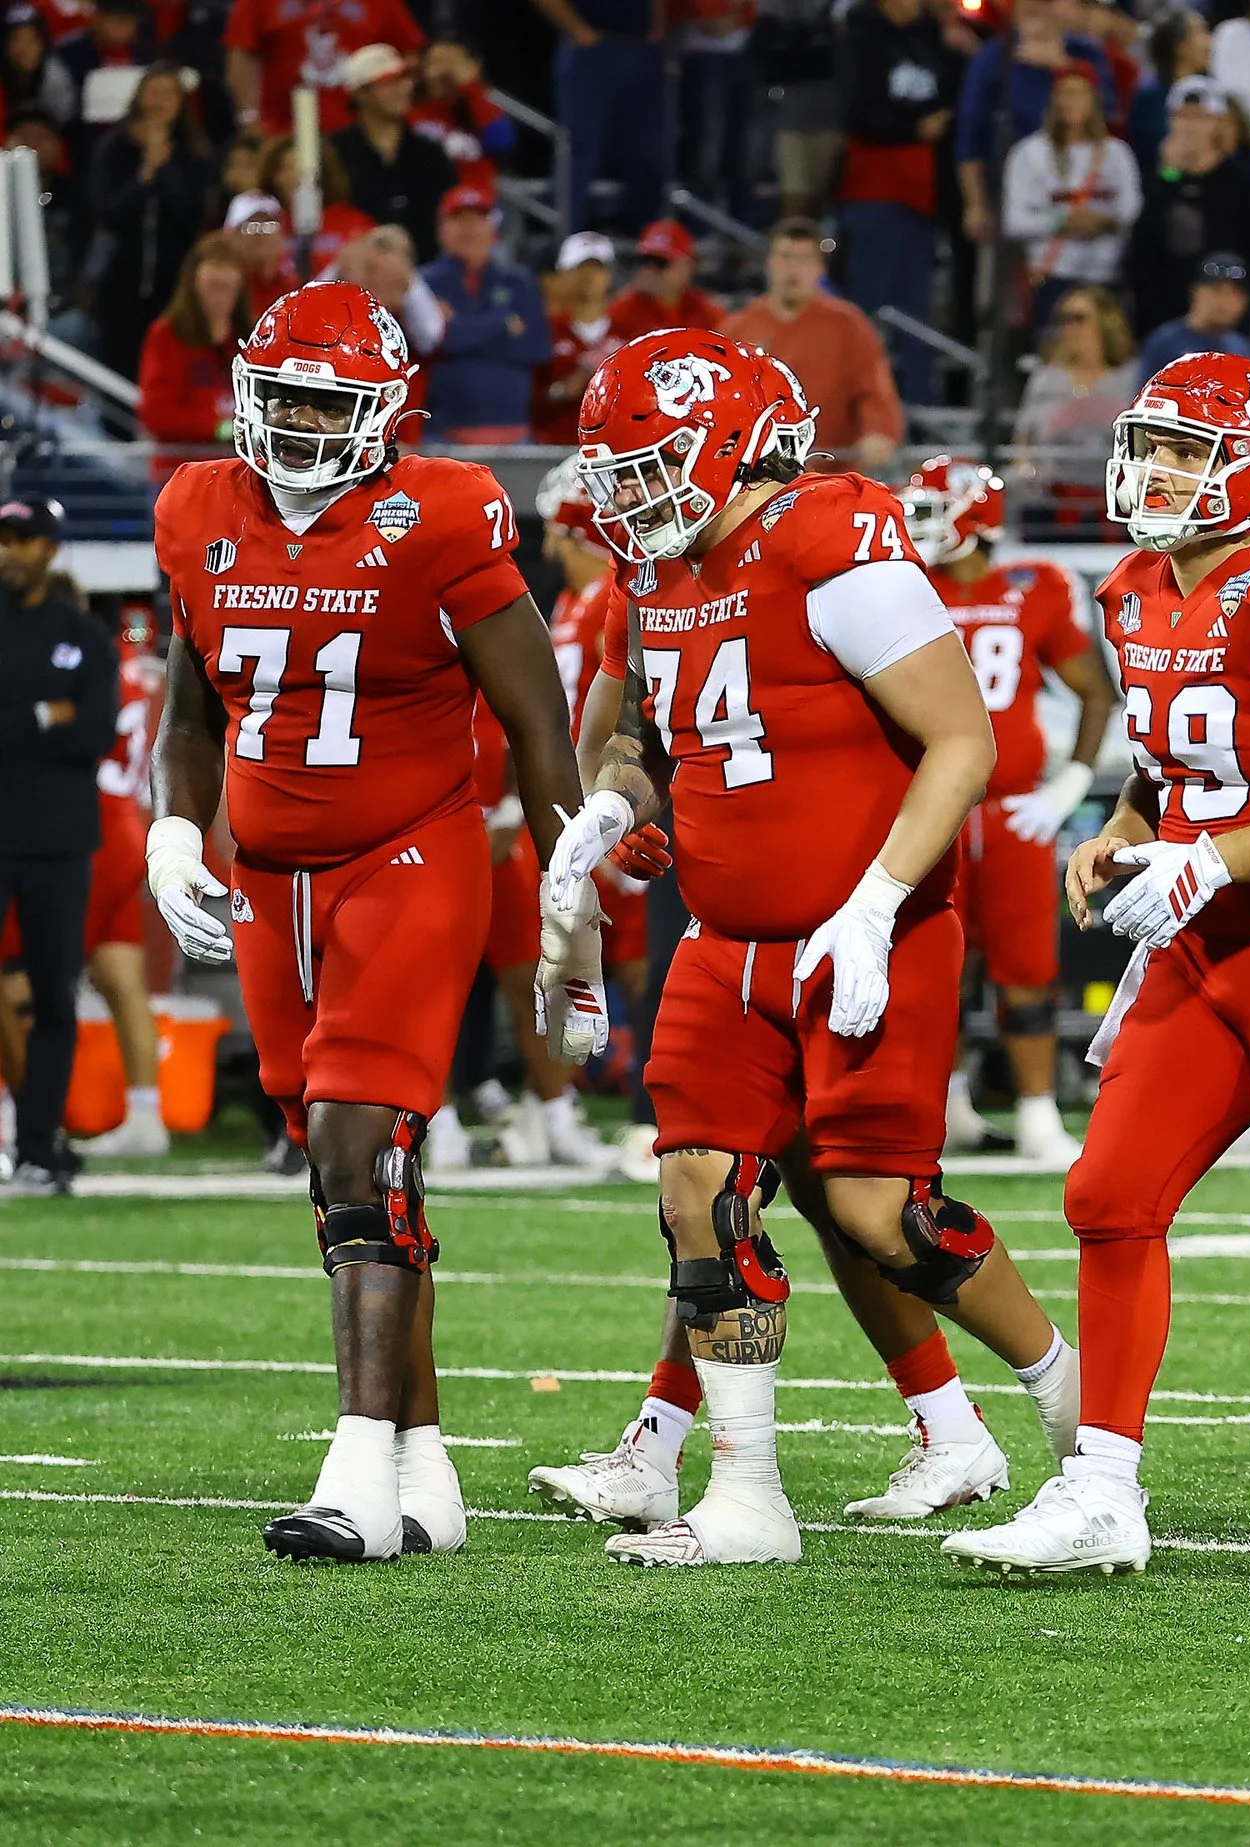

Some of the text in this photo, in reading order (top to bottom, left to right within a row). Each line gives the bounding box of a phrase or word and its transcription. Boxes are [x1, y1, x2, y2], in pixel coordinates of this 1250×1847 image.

[373, 509, 416, 519] ARIZONA
[379, 517, 408, 526] BOWL
[852, 512, 905, 562] 74
[213, 584, 379, 614] FRESNO STATE
[639, 590, 749, 632] FRESNO STATE
[956, 624, 1024, 712] 8
[1124, 641, 1226, 673] FRESNO STATE
[217, 626, 363, 767] 71
[642, 637, 774, 790] 74
[1122, 683, 1250, 822] 69
[738, 1311, 780, 1339] BOY
